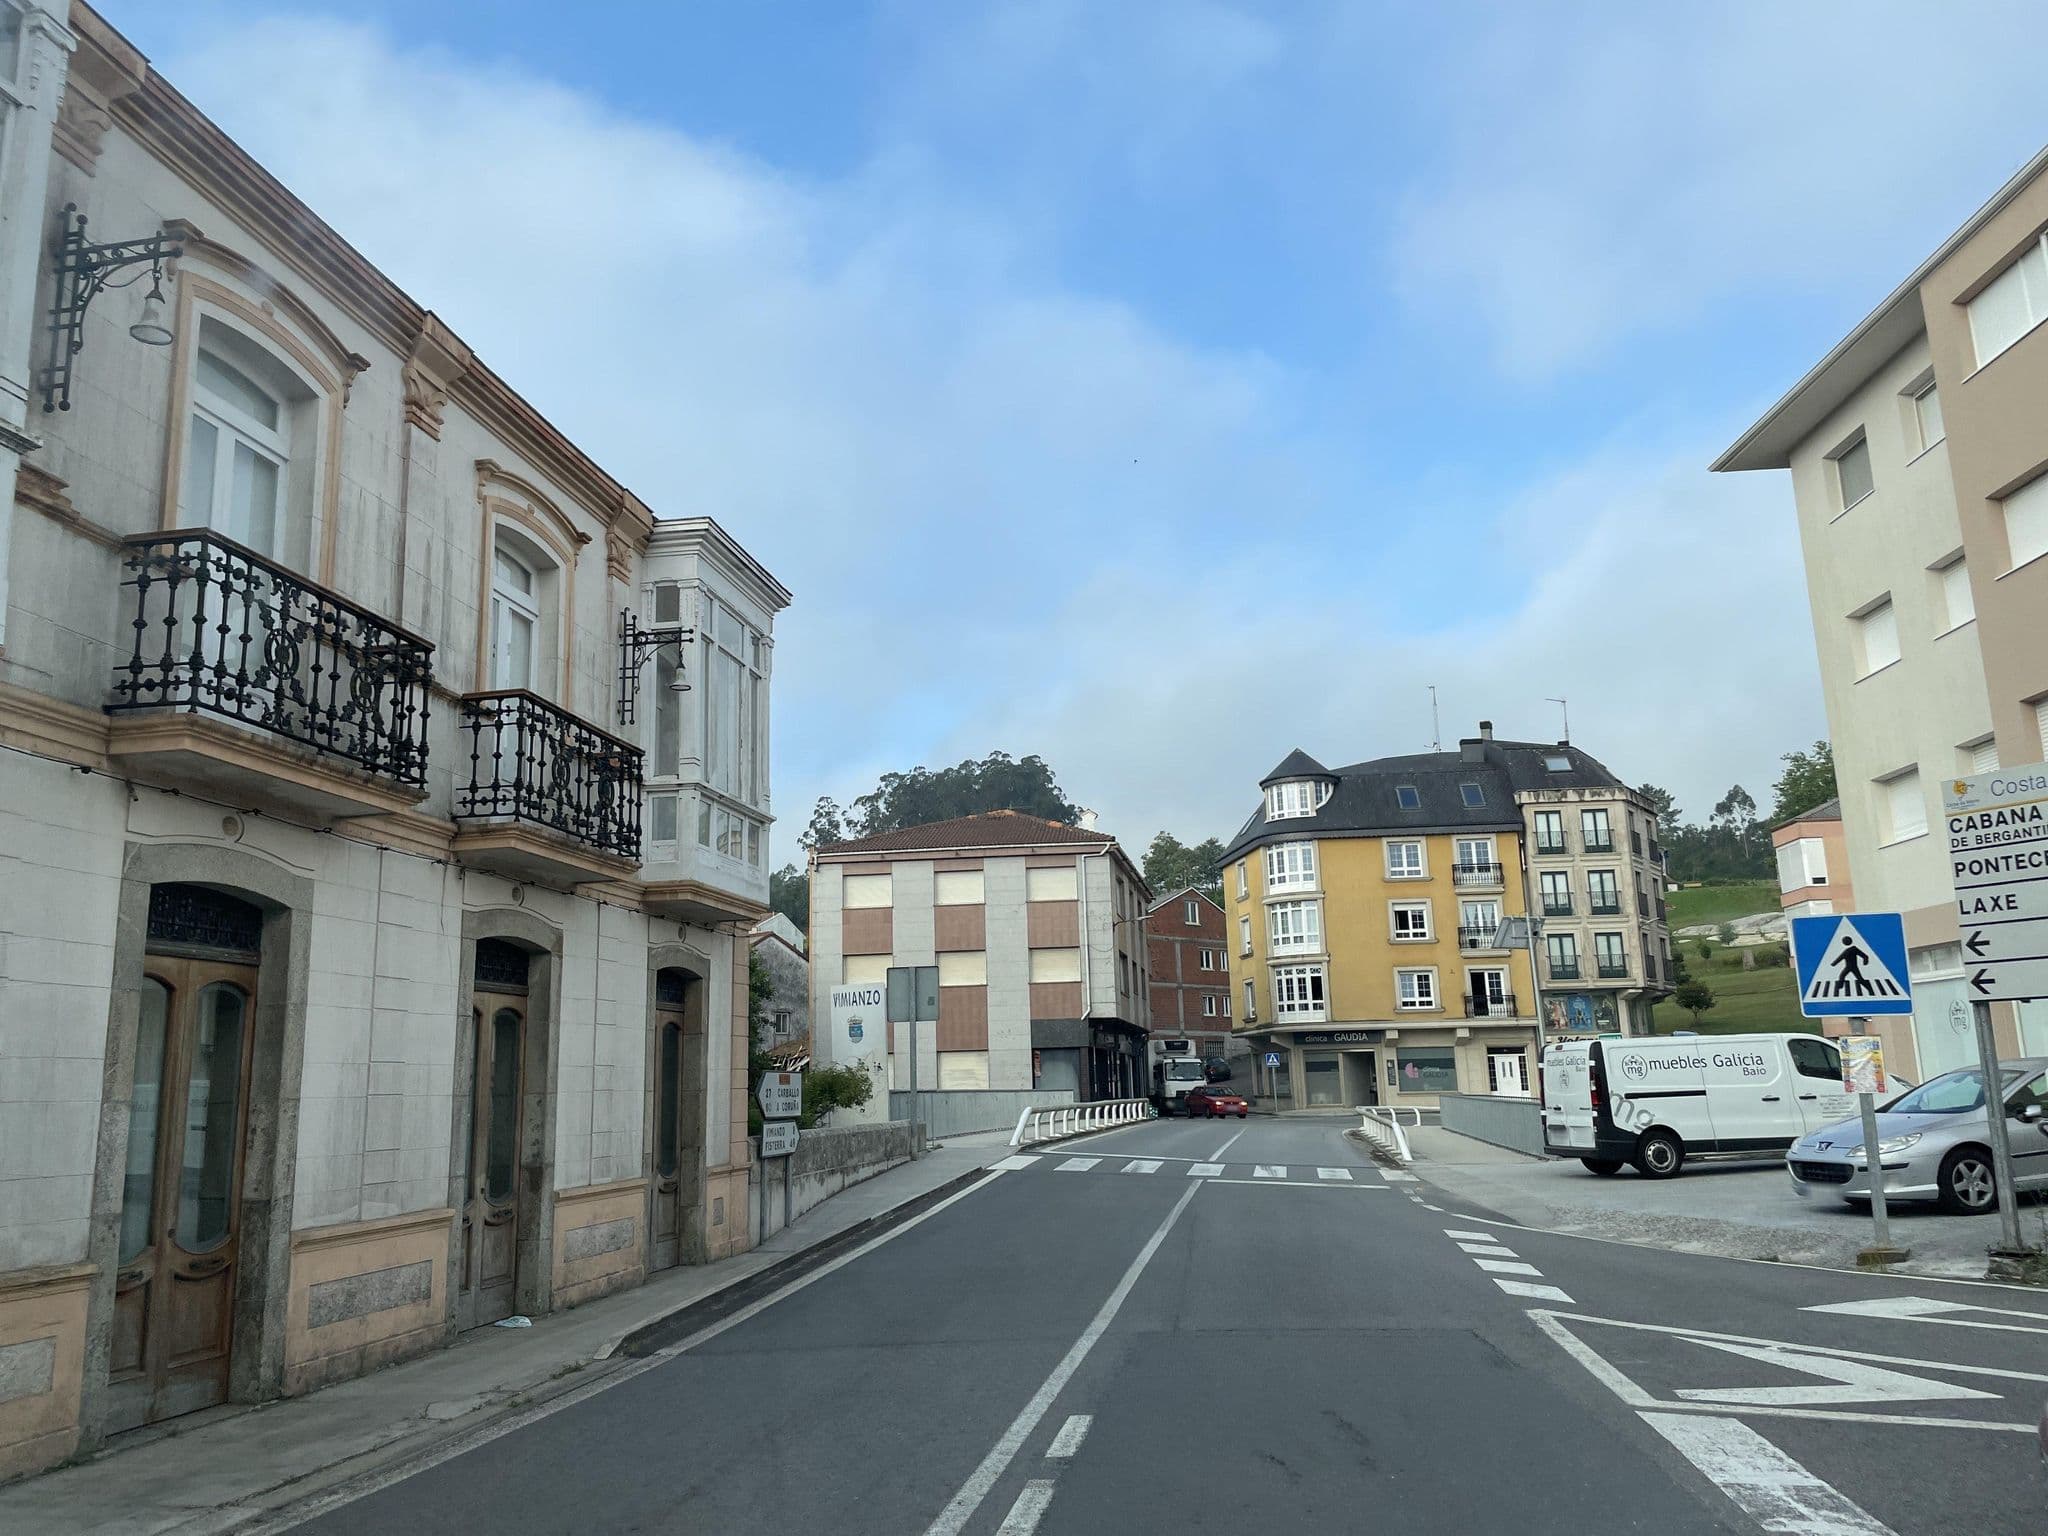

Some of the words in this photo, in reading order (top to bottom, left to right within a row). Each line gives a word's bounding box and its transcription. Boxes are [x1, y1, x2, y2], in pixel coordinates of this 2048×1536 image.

[1990, 775, 2047, 797] Costa
[1949, 805, 2043, 834] CABANA
[1951, 836, 1969, 848] DE
[1975, 824, 2048, 845] BERGANTI
[1959, 893, 2019, 915] LAXE
[832, 989, 881, 1008] VIMIANZO
[1649, 1055, 1708, 1071] muebles
[1712, 1053, 1765, 1068] Galicia
[1742, 1066, 1767, 1076] Baio
